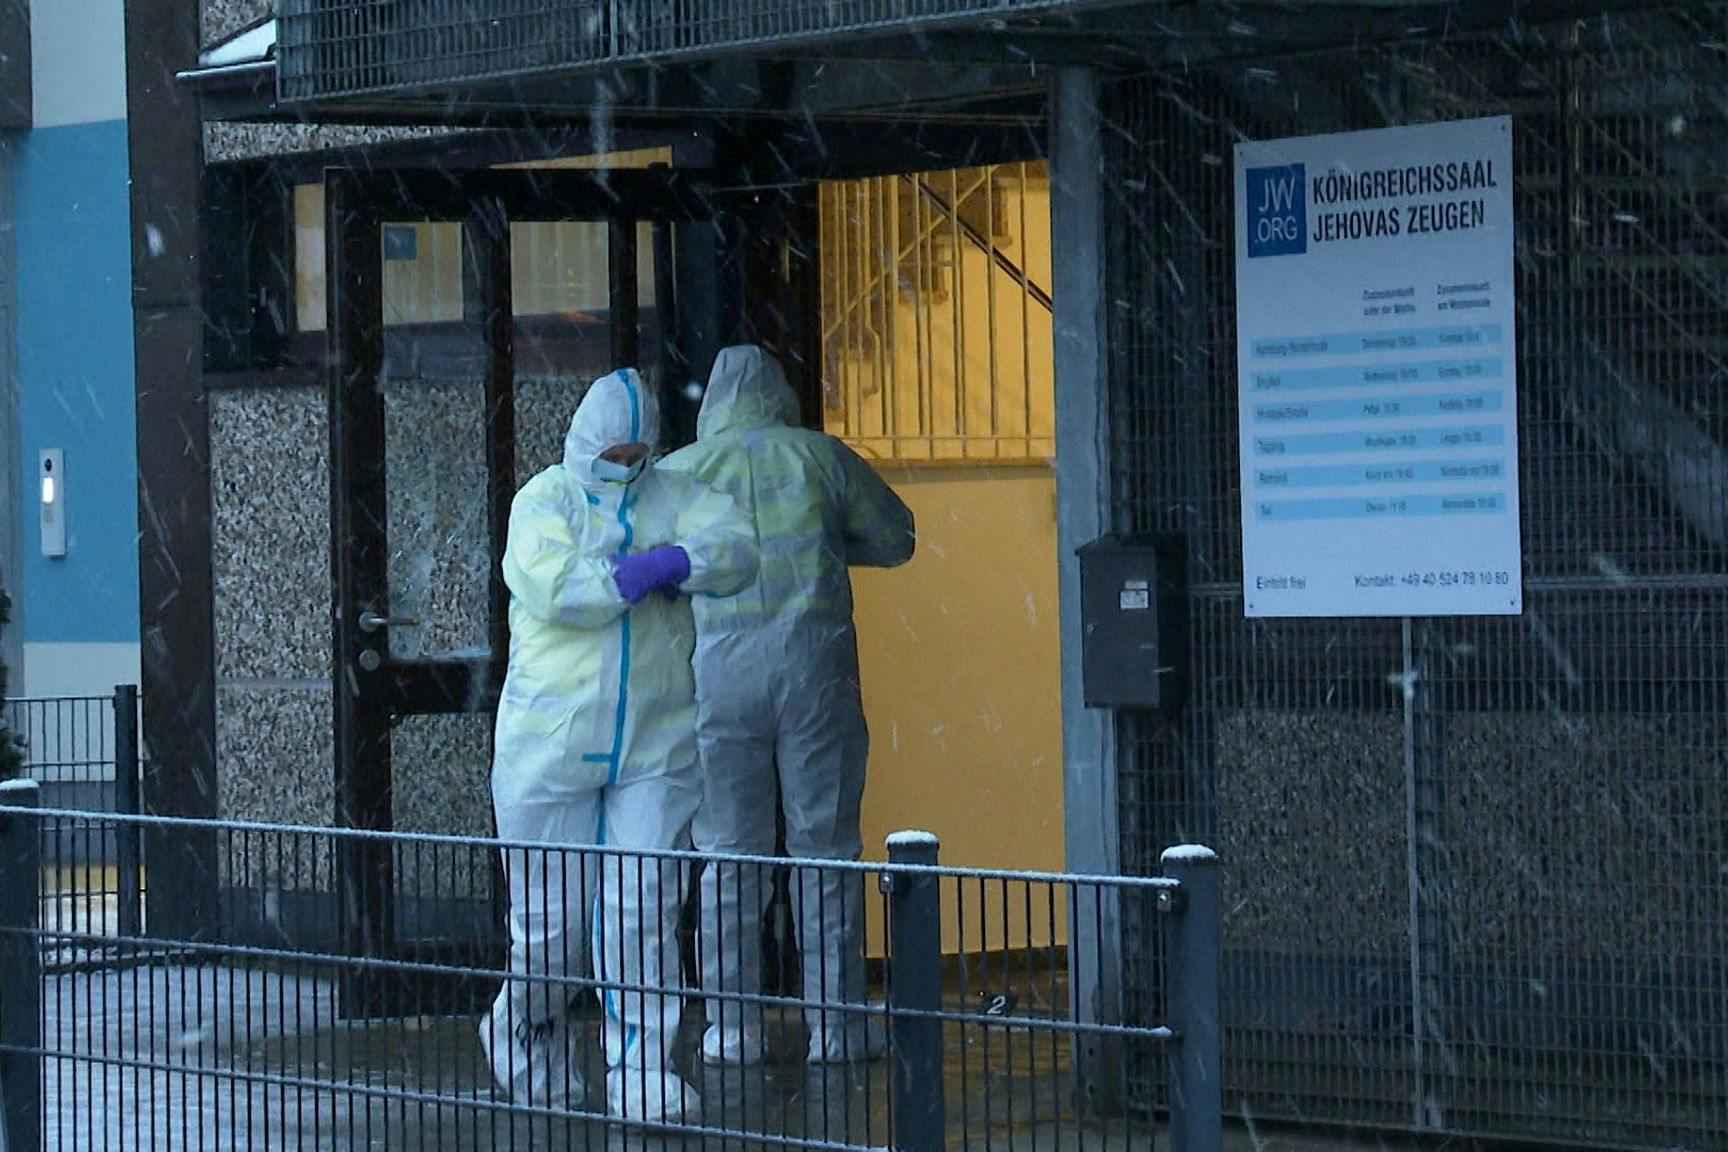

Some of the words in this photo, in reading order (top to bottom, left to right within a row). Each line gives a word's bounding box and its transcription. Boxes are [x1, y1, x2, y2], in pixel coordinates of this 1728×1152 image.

[1258, 176, 1296, 212] JW
[1313, 160, 1498, 204] KÖNIGREICHSSAAL
[1313, 207, 1400, 242] JEHOVAS
[1407, 199, 1485, 234] ZEUGEN
[1290, 575, 1306, 589] frei
[1401, 573, 1420, 586] +49
[1422, 572, 1437, 586] 40
[1439, 572, 1459, 586] 524
[986, 995, 1006, 1014] 2
